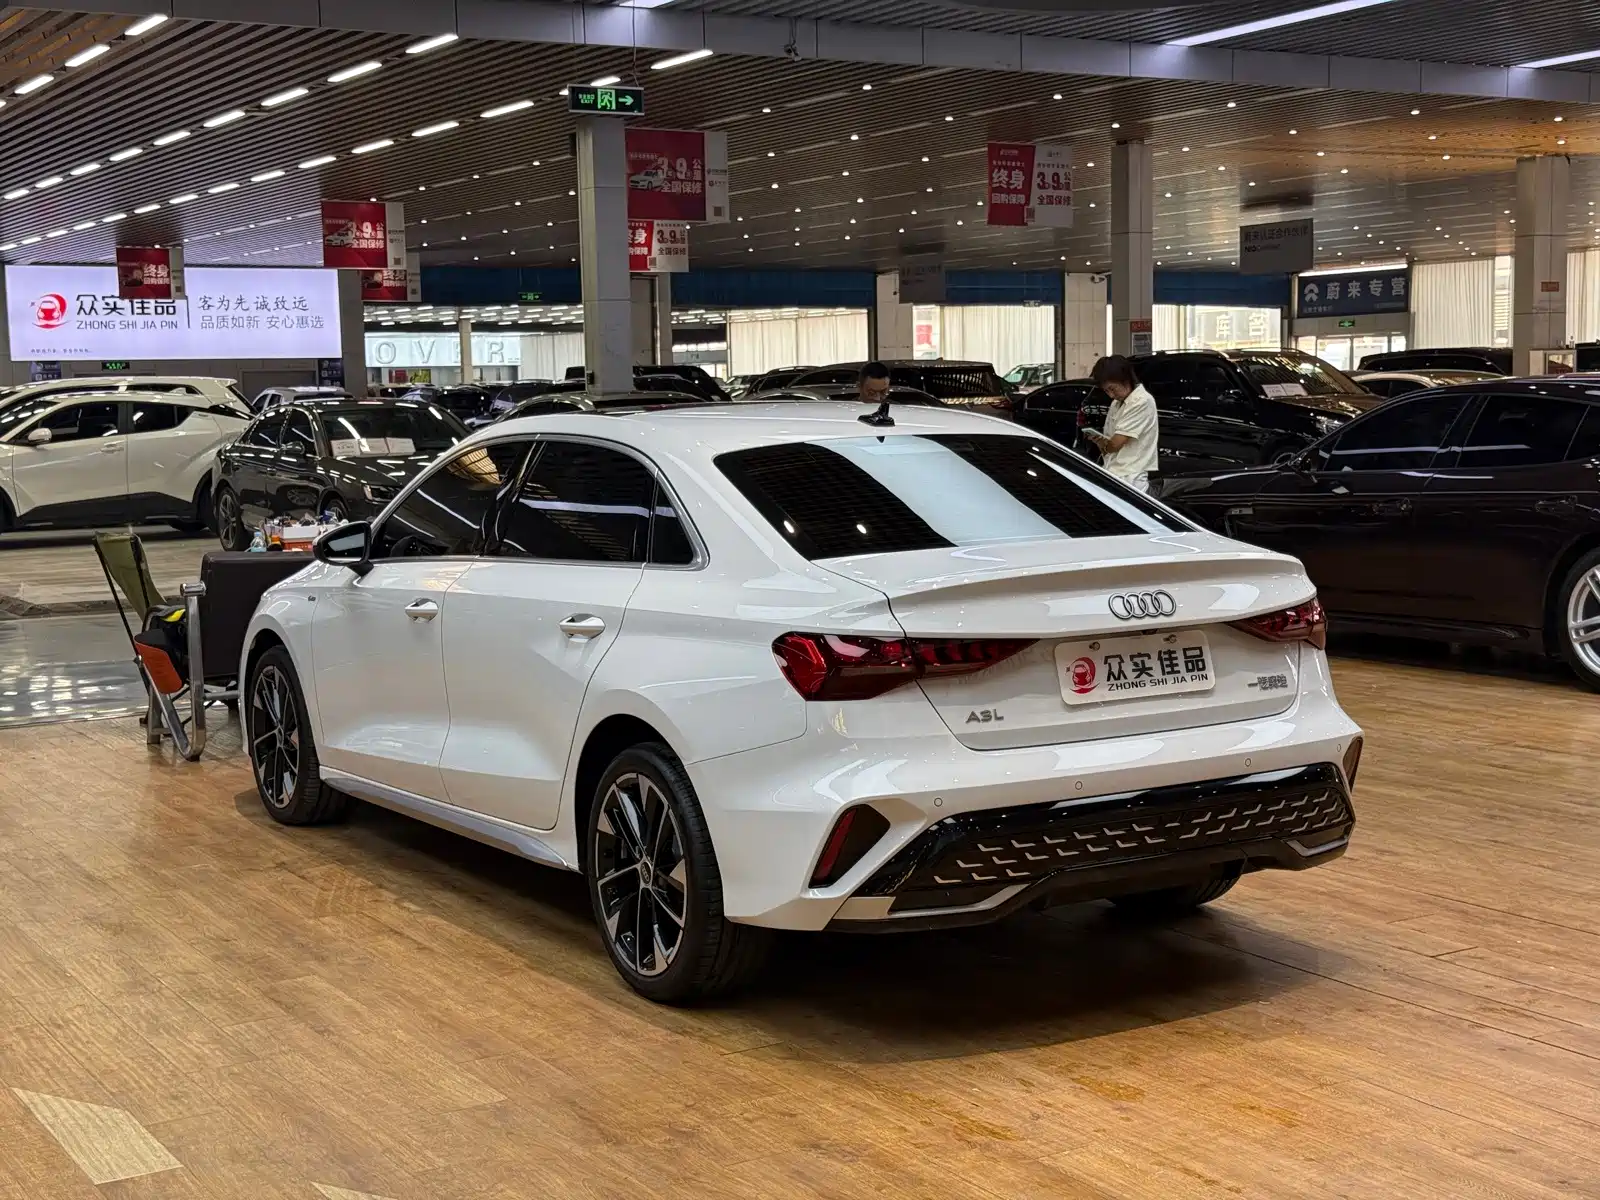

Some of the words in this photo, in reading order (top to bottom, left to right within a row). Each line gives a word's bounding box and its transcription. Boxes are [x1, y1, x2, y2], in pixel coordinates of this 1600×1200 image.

[992, 168, 1025, 190] 终身
[661, 181, 702, 194] 全国保修
[1037, 195, 1071, 206] 全国保修
[352, 239, 384, 249] 全国保修
[658, 247, 687, 256] 全国保修
[143, 264, 169, 278] 终身
[1326, 277, 1406, 300] 蔚来专营
[76, 294, 177, 316] 众实佳品
[76, 320, 116, 330] ZHONG
[120, 320, 137, 330] SHI
[140, 320, 157, 330] JIA
[161, 320, 178, 330] PIN
[200, 315, 260, 329] 品质如新
[266, 315, 325, 329] 安心惠选
[1103, 646, 1206, 682] 众实佳品
[1108, 680, 1146, 691] ZHONG
[1150, 678, 1168, 687] SHI
[1171, 676, 1188, 684] JIA
[1191, 673, 1208, 682] PIN
[966, 709, 1004, 723] A3L
